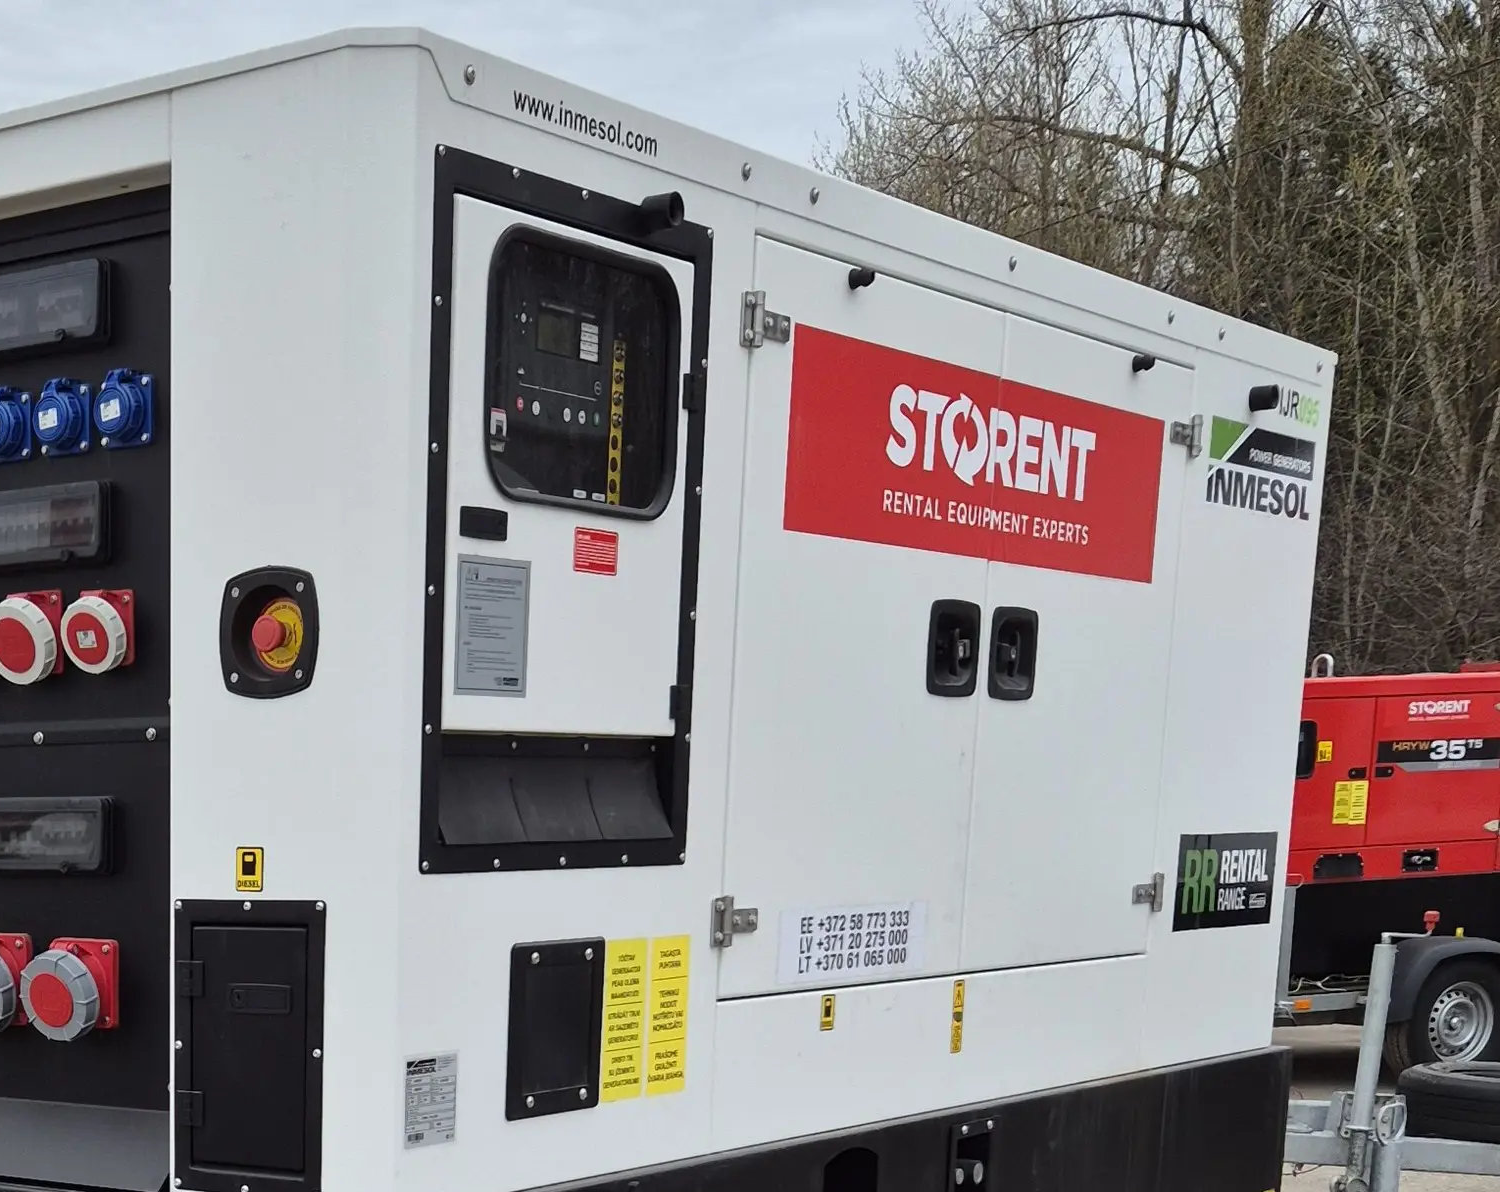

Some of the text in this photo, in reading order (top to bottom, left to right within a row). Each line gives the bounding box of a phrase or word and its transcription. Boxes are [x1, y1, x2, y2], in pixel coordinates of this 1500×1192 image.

[513, 90, 658, 157] www.inmesol.com
[886, 384, 1096, 501] STORENT
[1206, 467, 1310, 520] INMESOL
[883, 489, 1089, 545] RENTAL EQUIPMENT EXPERTS
[1408, 700, 1471, 715] STORENT
[1429, 739, 1467, 760] 35
[1181, 849, 1219, 914] RR
[1219, 849, 1268, 884] RENTAL
[1217, 887, 1246, 911] RANGE
[801, 911, 909, 934] EE +372 58 773 333
[800, 929, 908, 954] LV +371 20 275 000
[798, 947, 907, 974] LT +370 61 065 000
